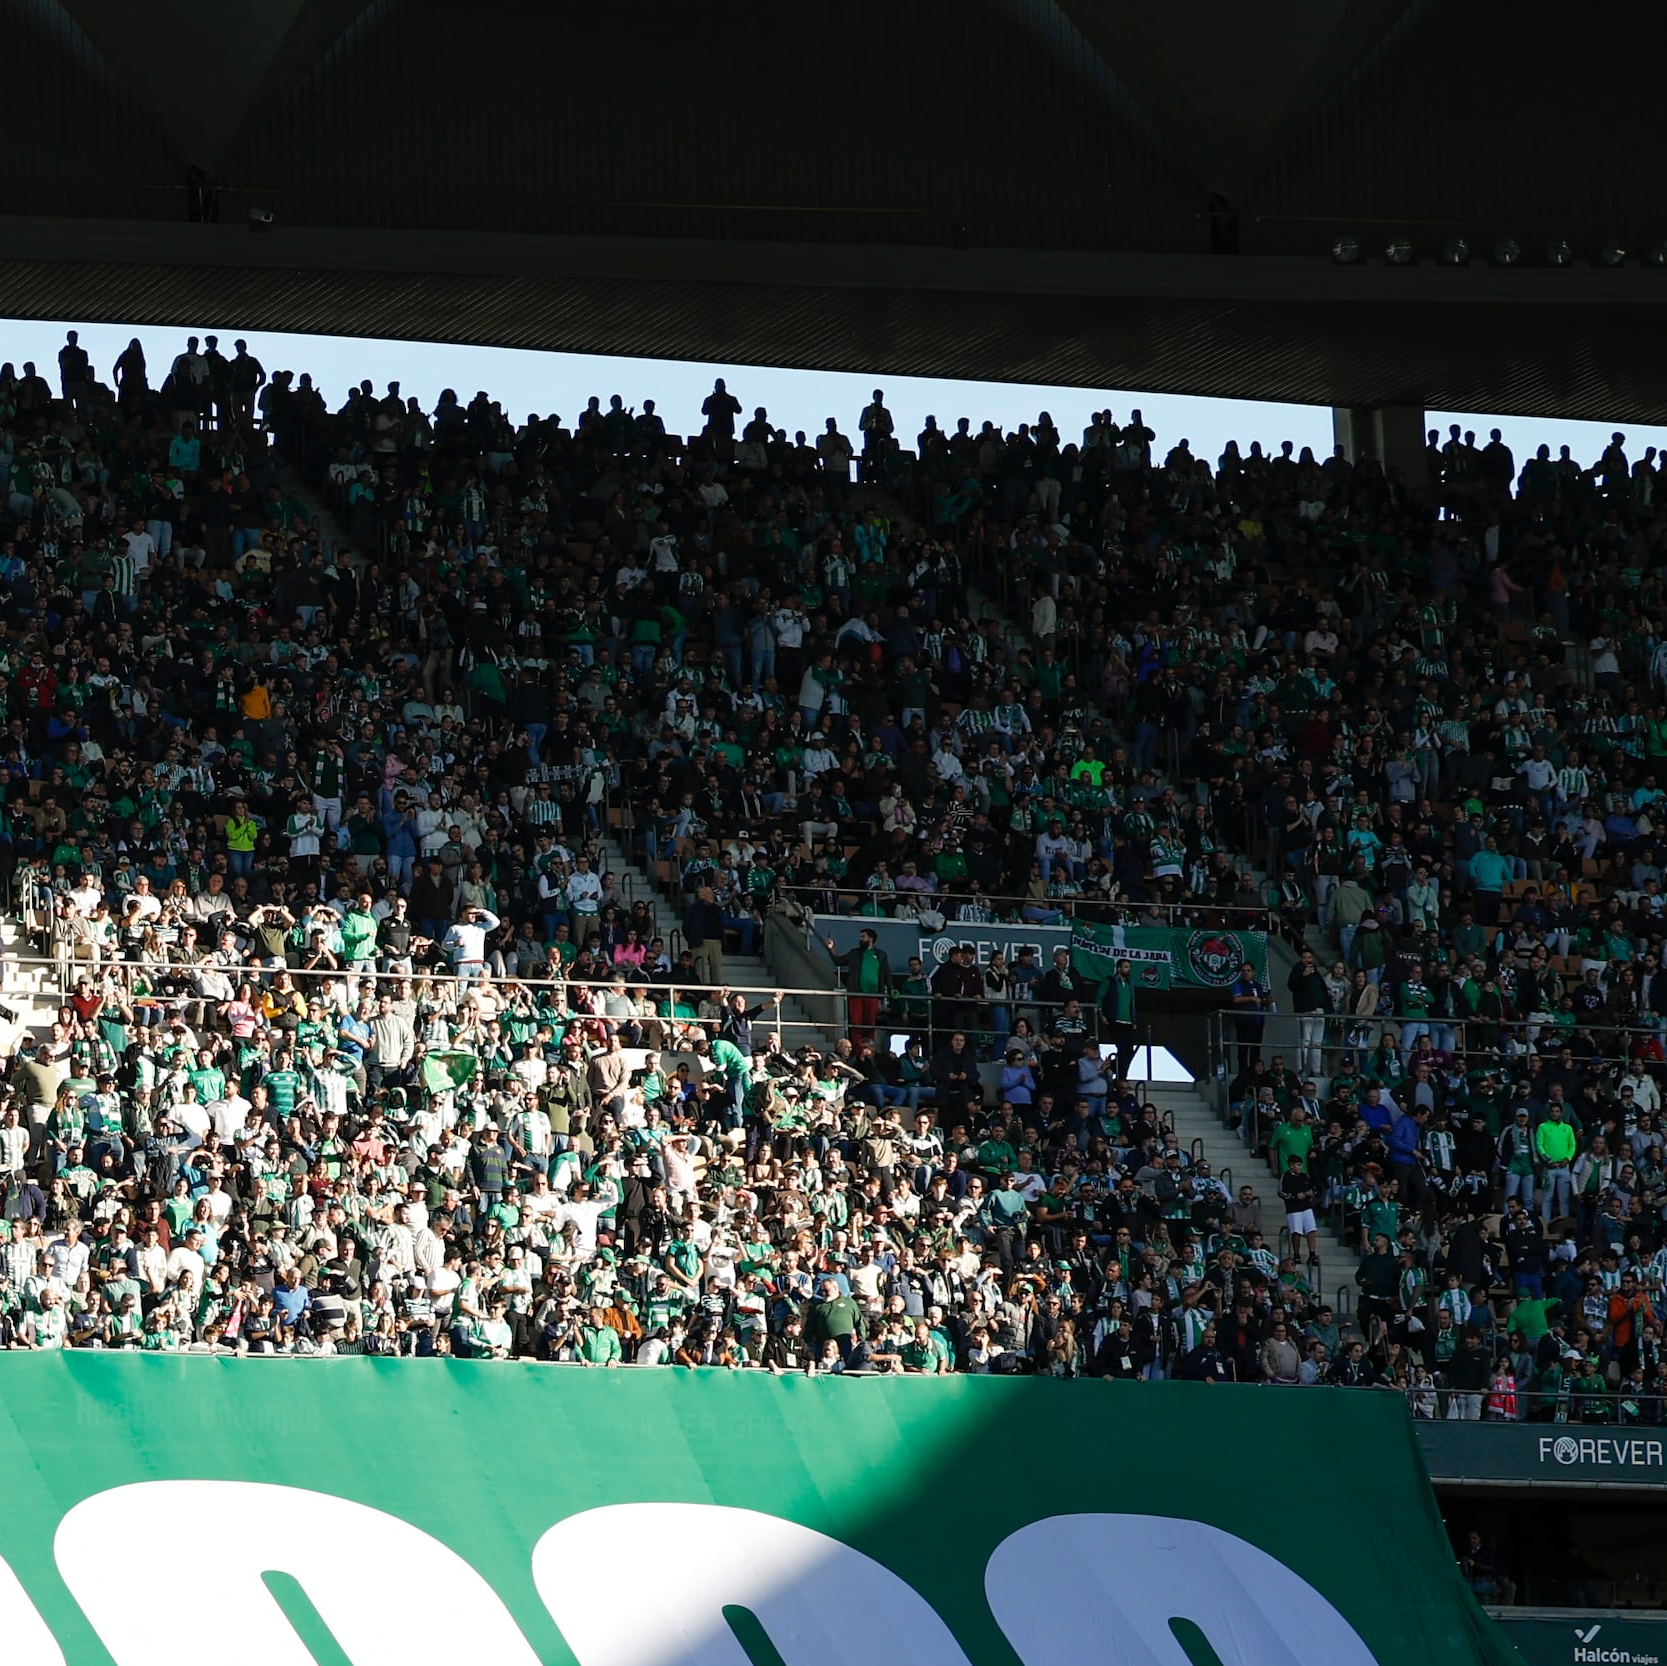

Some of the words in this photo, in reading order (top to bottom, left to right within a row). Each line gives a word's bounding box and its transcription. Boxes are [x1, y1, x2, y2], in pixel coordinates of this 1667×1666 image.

[1538, 1436, 1664, 1465] FOREVER
[1574, 1647, 1630, 1664] Halcón
[1632, 1652, 1658, 1665] viajes
